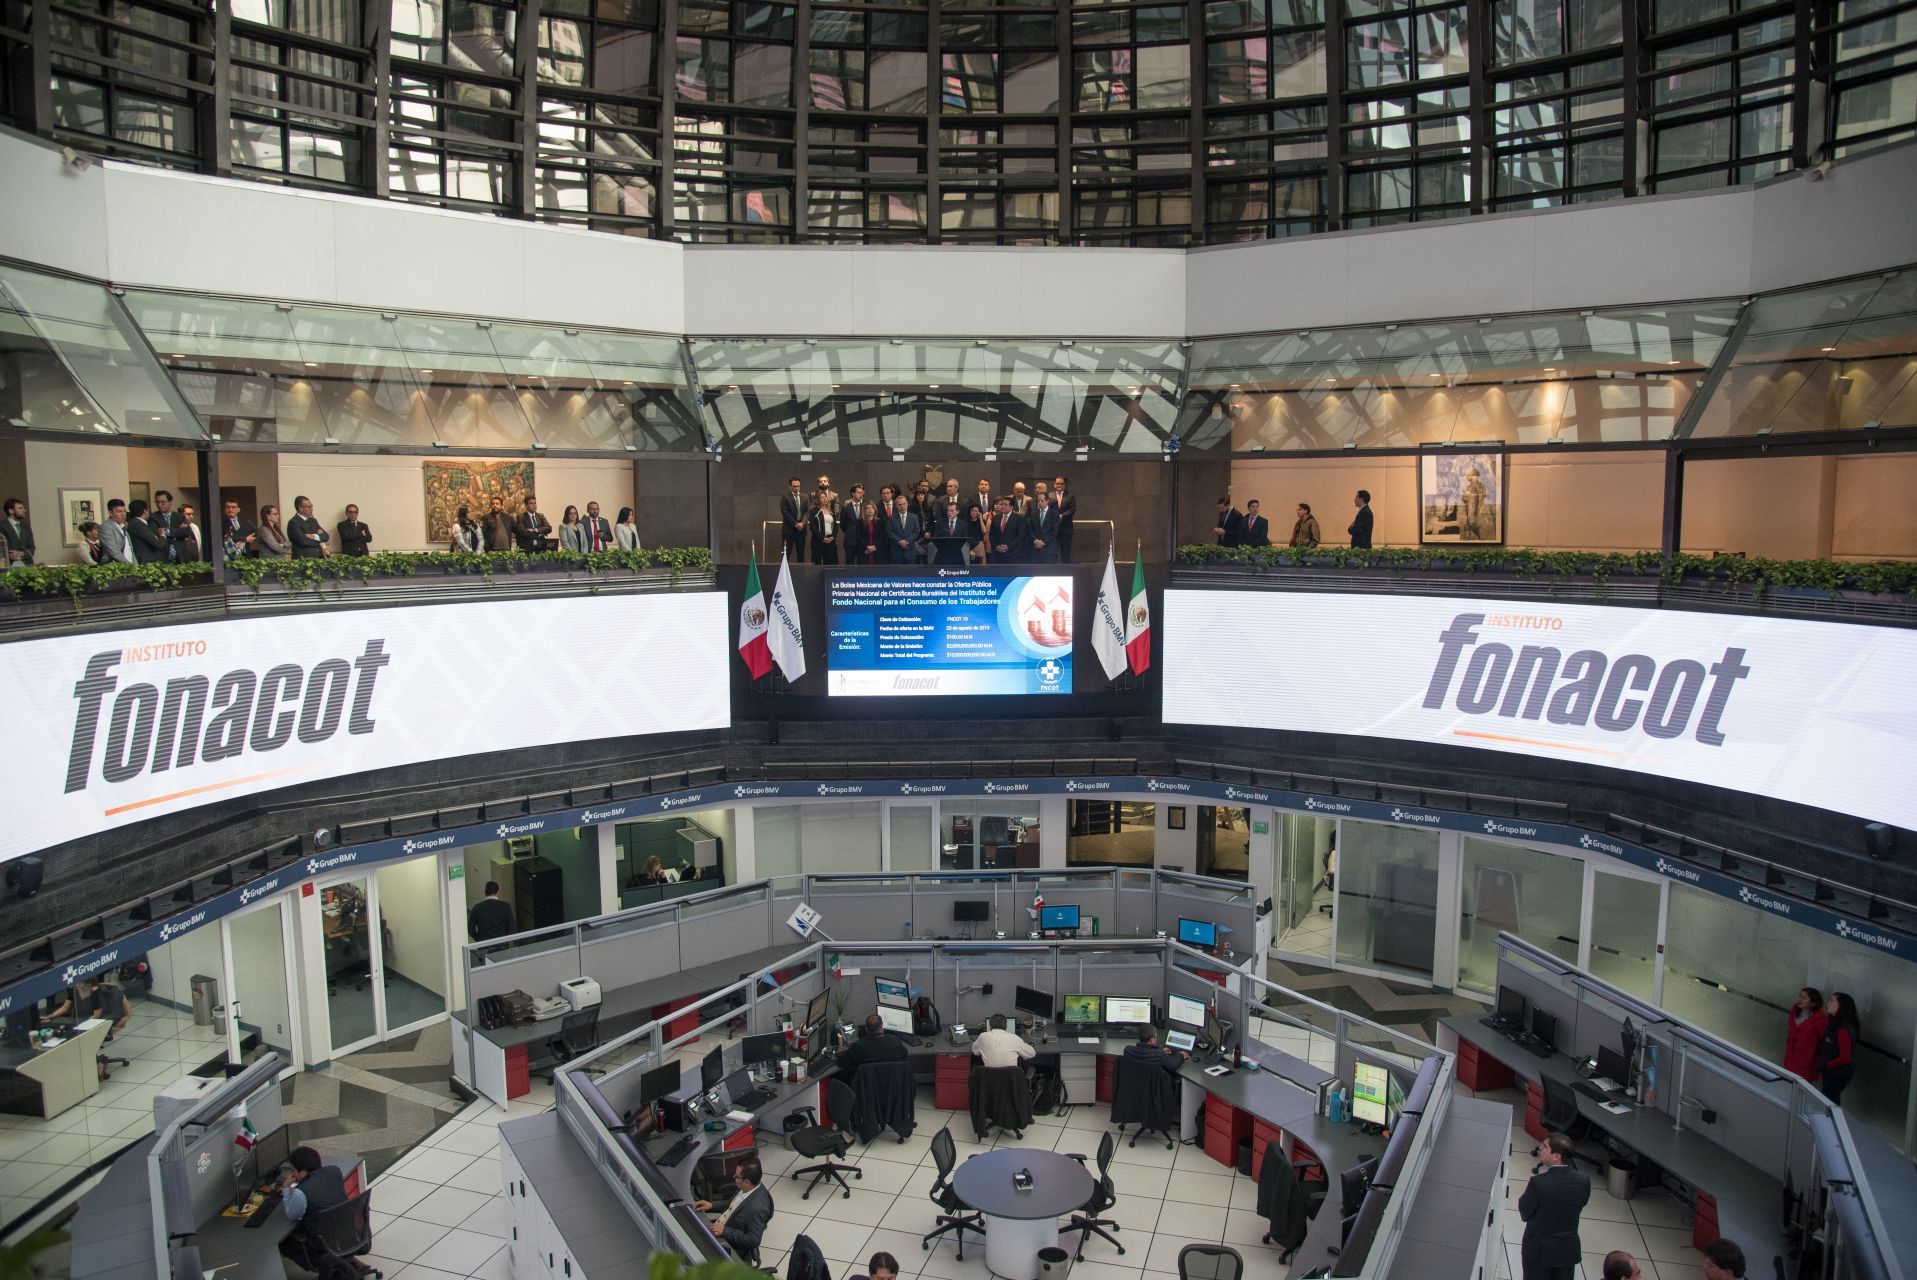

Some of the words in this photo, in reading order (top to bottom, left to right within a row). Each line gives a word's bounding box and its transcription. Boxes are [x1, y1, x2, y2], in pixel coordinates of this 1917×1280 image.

[777, 605, 794, 630] Grupo
[792, 628, 803, 648] BMV
[1101, 604, 1115, 630] Grupo
[1113, 627, 1125, 646] BMV
[1488, 614, 1563, 630] INSTITUTO
[126, 640, 206, 663] INSTITUTO
[893, 674, 940, 690] fonacot
[1422, 613, 1751, 747] fonacot
[64, 638, 391, 794] fonacot
[746, 788, 764, 796] Grupo
[829, 786, 848, 795] Grupo
[912, 786, 931, 794] Grupo
[996, 784, 1014, 793] Grupo
[1078, 783, 1095, 791] Grupo
[671, 798, 687, 807] Grupo
[688, 795, 701, 803] BMV
[1237, 791, 1254, 800] Grupo
[594, 810, 611, 820] Grupo
[612, 808, 625, 816] BMV
[1317, 802, 1336, 811] Grupo
[1336, 804, 1350, 812] BMV
[1404, 812, 1424, 822] Grupo
[1424, 815, 1440, 823] BMV
[509, 825, 529, 834] Grupo
[530, 821, 544, 830] BMV
[1498, 824, 1519, 834] Grupo
[1520, 827, 1536, 836] BMV
[417, 840, 438, 849] Grupo
[439, 836, 454, 845] BMV
[1592, 840, 1610, 851] Grupo
[1610, 845, 1622, 855] BMV
[319, 857, 339, 868] Grupo
[339, 853, 357, 863] BMV
[1667, 865, 1684, 877] Grupo
[1685, 871, 1699, 881] BMV
[250, 885, 266, 898] Grupo
[267, 879, 278, 891] BMV
[1752, 894, 1773, 908] Grupo
[1774, 902, 1790, 913] BMV
[172, 919, 190, 932] Grupo
[191, 912, 205, 925] BMV
[1852, 927, 1876, 943] Grupo
[1876, 936, 1897, 949] BMV
[78, 960, 100, 975] Grupo
[101, 950, 118, 965] BMV
[0, 996, 11, 1010] MV
